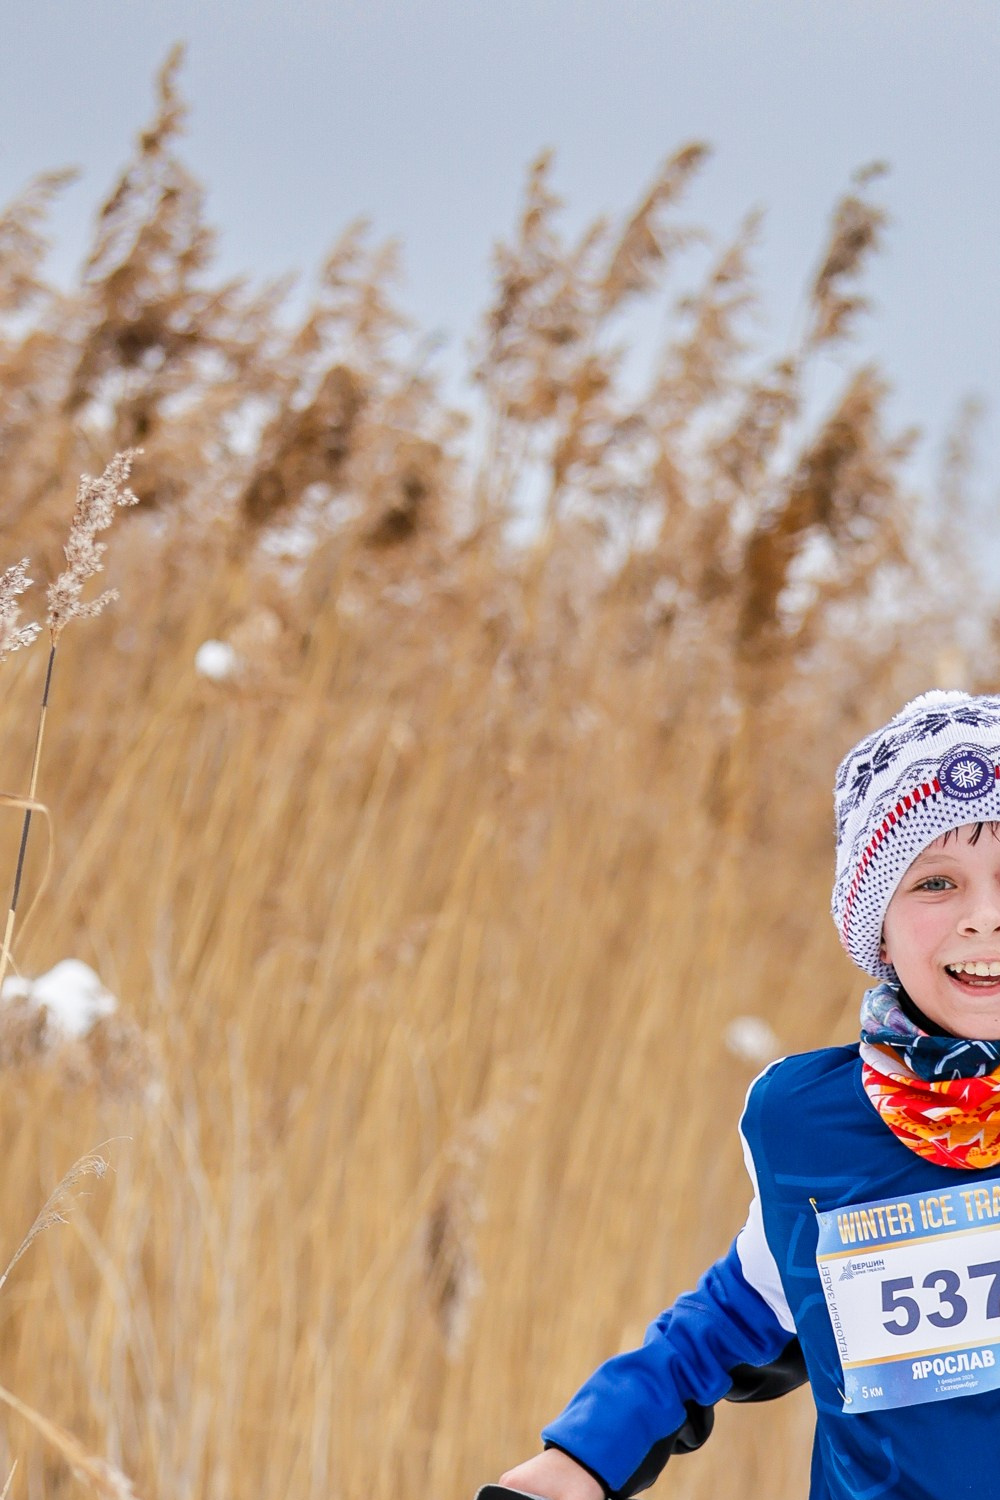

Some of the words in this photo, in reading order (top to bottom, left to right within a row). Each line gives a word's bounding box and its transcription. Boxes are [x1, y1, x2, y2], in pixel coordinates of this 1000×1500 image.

[943, 776, 995, 799] ПОЛУМАРАФОН
[837, 1200, 915, 1245] WINTER
[918, 1195, 956, 1229] ICE
[851, 1259, 885, 1270] ВЕРШИН
[820, 1263, 836, 1300] ЗАБЕГ
[829, 1302, 850, 1362] ЛЕДОВЫЙ
[911, 1349, 996, 1380] ЯРОСЛАВ
[861, 1386, 869, 1399] 5
